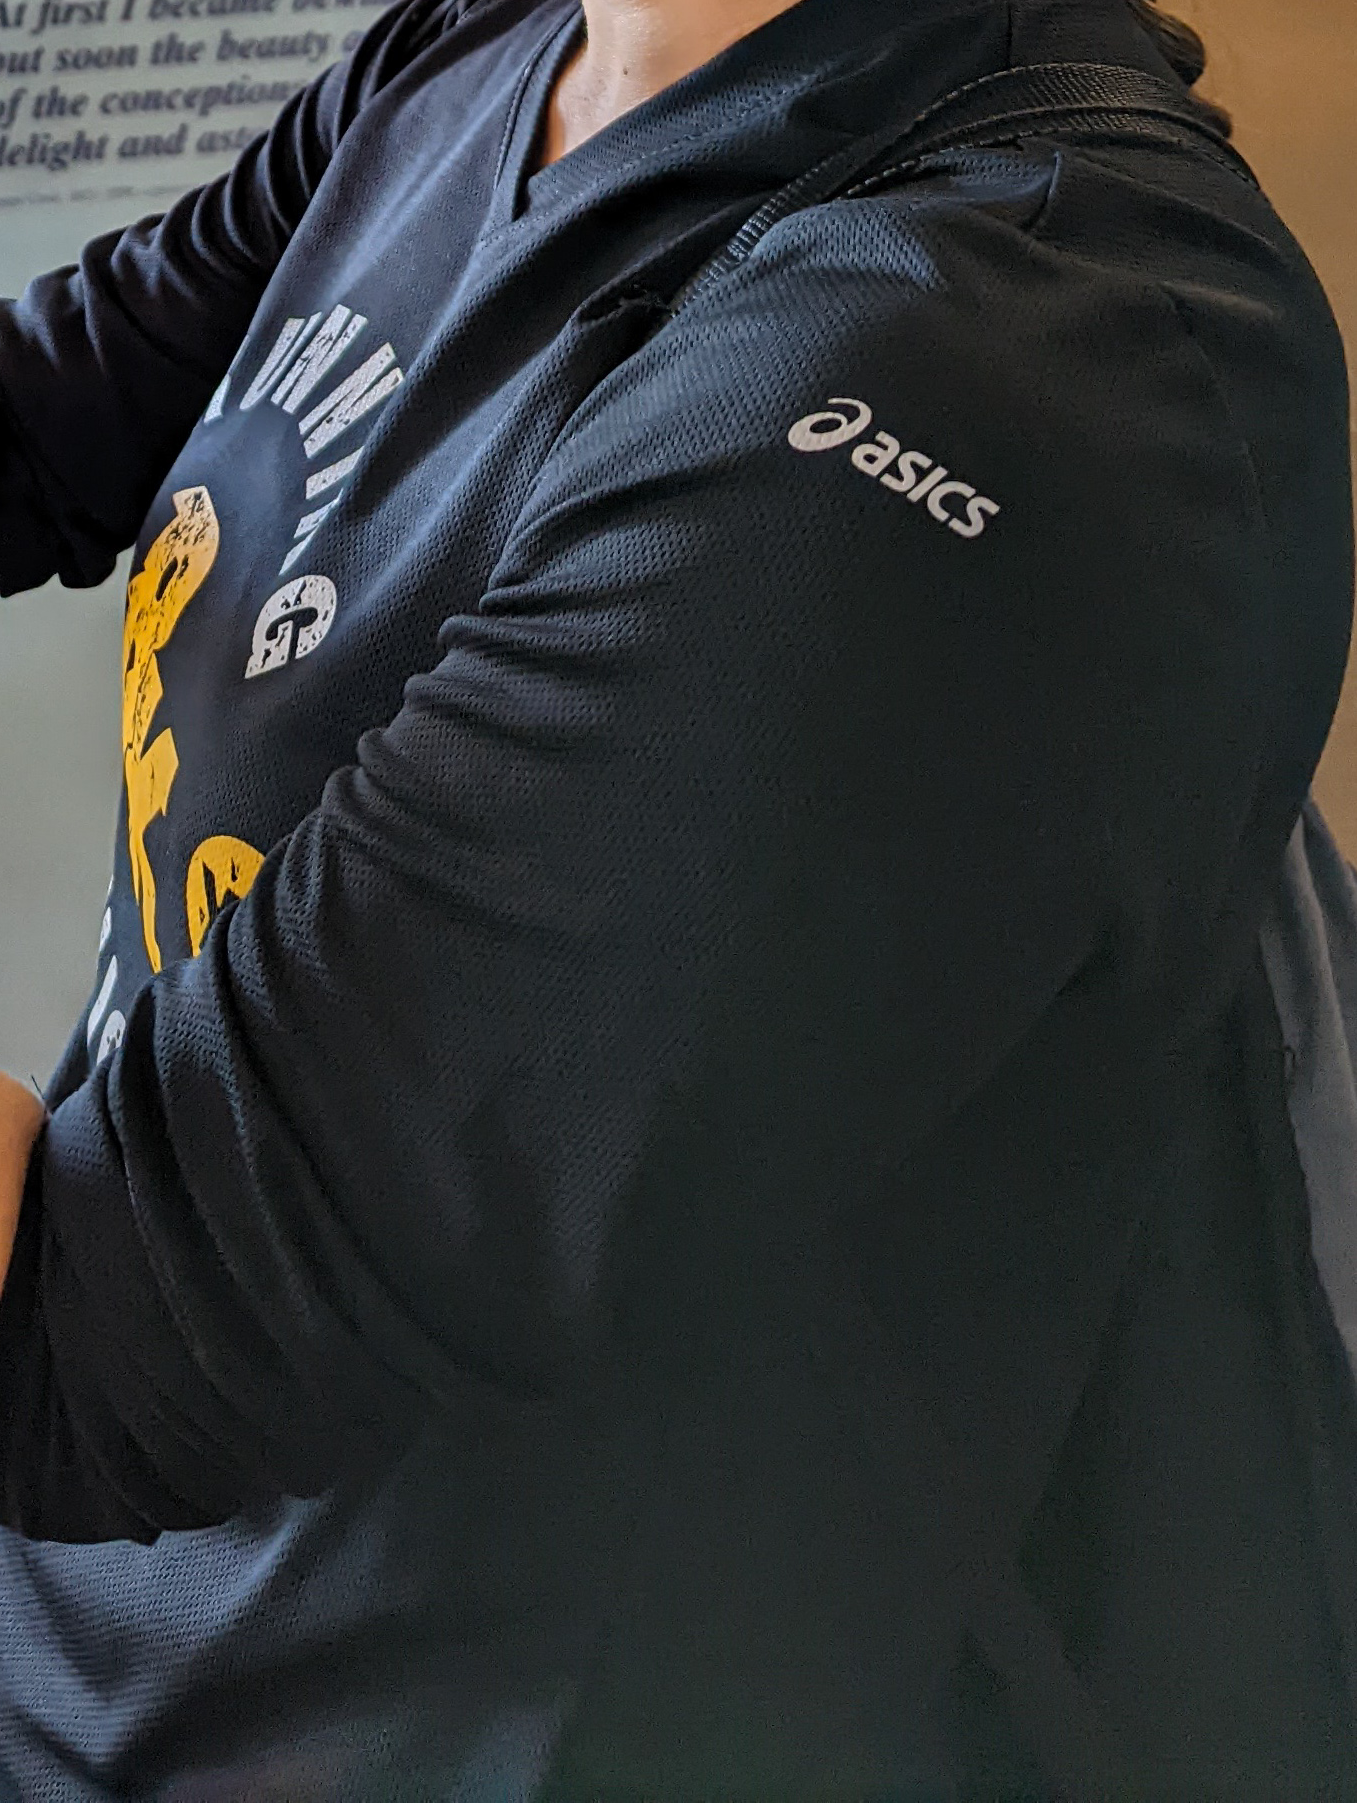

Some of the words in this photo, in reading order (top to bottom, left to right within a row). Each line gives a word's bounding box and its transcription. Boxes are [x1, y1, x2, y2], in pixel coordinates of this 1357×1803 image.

[53, 44, 139, 72] soon
[150, 32, 206, 65] the
[217, 28, 330, 62] beauty
[32, 85, 89, 119] the
[118, 123, 188, 159] and
[851, 430, 1001, 539] asics
